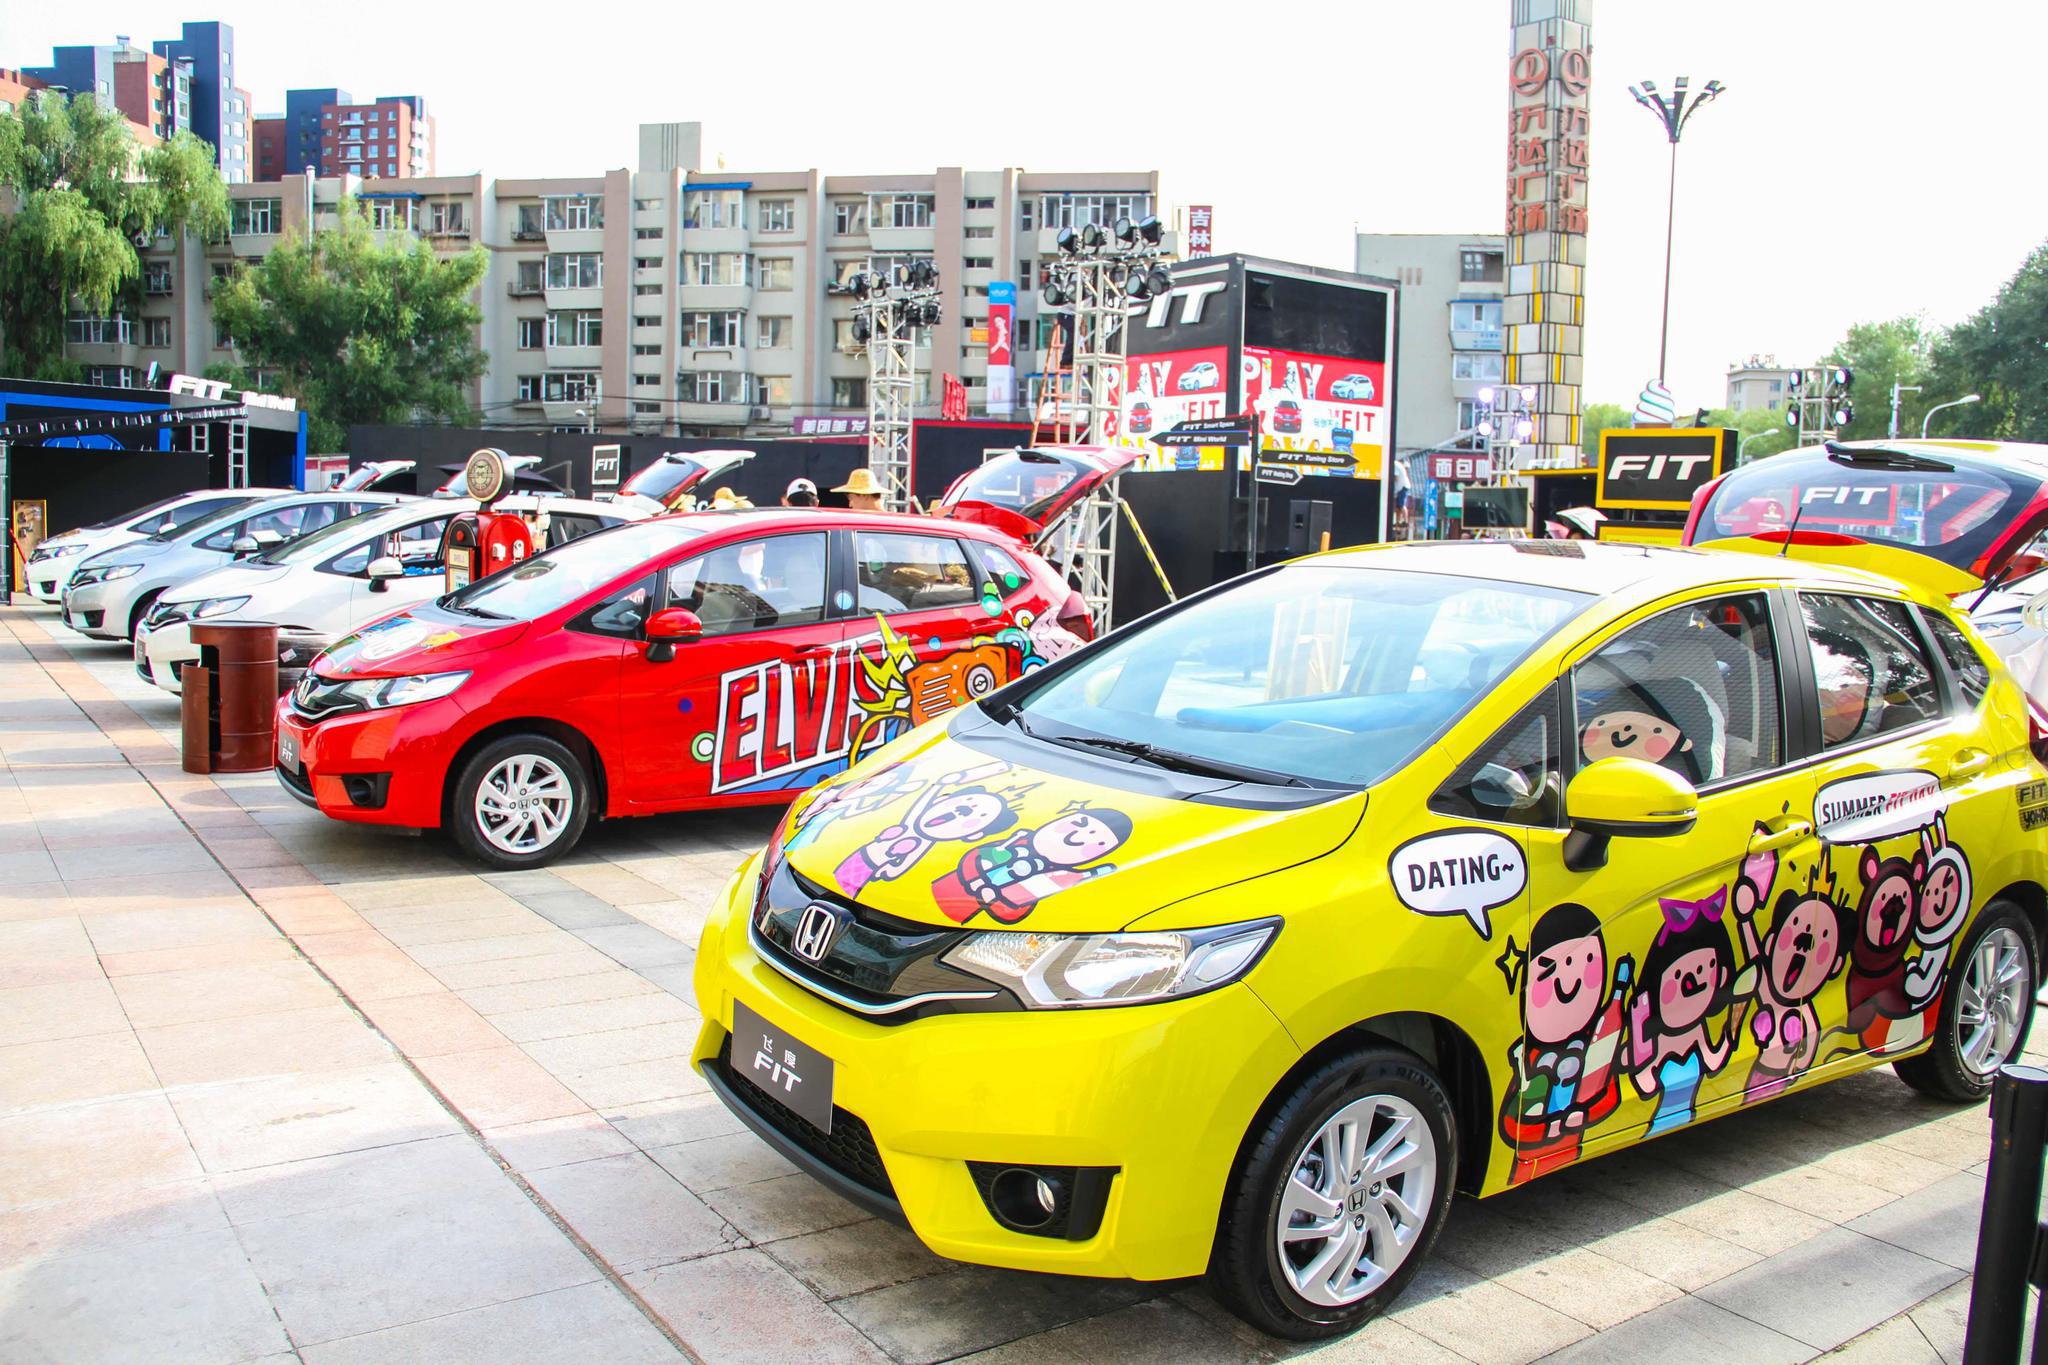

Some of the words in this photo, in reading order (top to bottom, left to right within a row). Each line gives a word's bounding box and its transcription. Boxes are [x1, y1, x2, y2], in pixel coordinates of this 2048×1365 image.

[1518, 103, 1547, 234] 万达广场
[1567, 106, 1590, 234] 万达广场
[169, 374, 233, 401] FIT
[1241, 354, 1324, 401] PLAY
[1188, 400, 1220, 421] FIT
[1342, 410, 1375, 432] FIT
[1182, 423, 1202, 431] FIT
[595, 458, 618, 471] FIT
[1305, 455, 1326, 463] Tuning
[1527, 459, 1571, 470] FIT
[1607, 455, 1712, 480] FIT
[1801, 487, 1889, 505] FIT
[2018, 782, 2046, 803] FIT
[1822, 795, 1885, 824] SUMMER
[762, 1034, 798, 1069] 飞度
[753, 1050, 802, 1093] FIT
